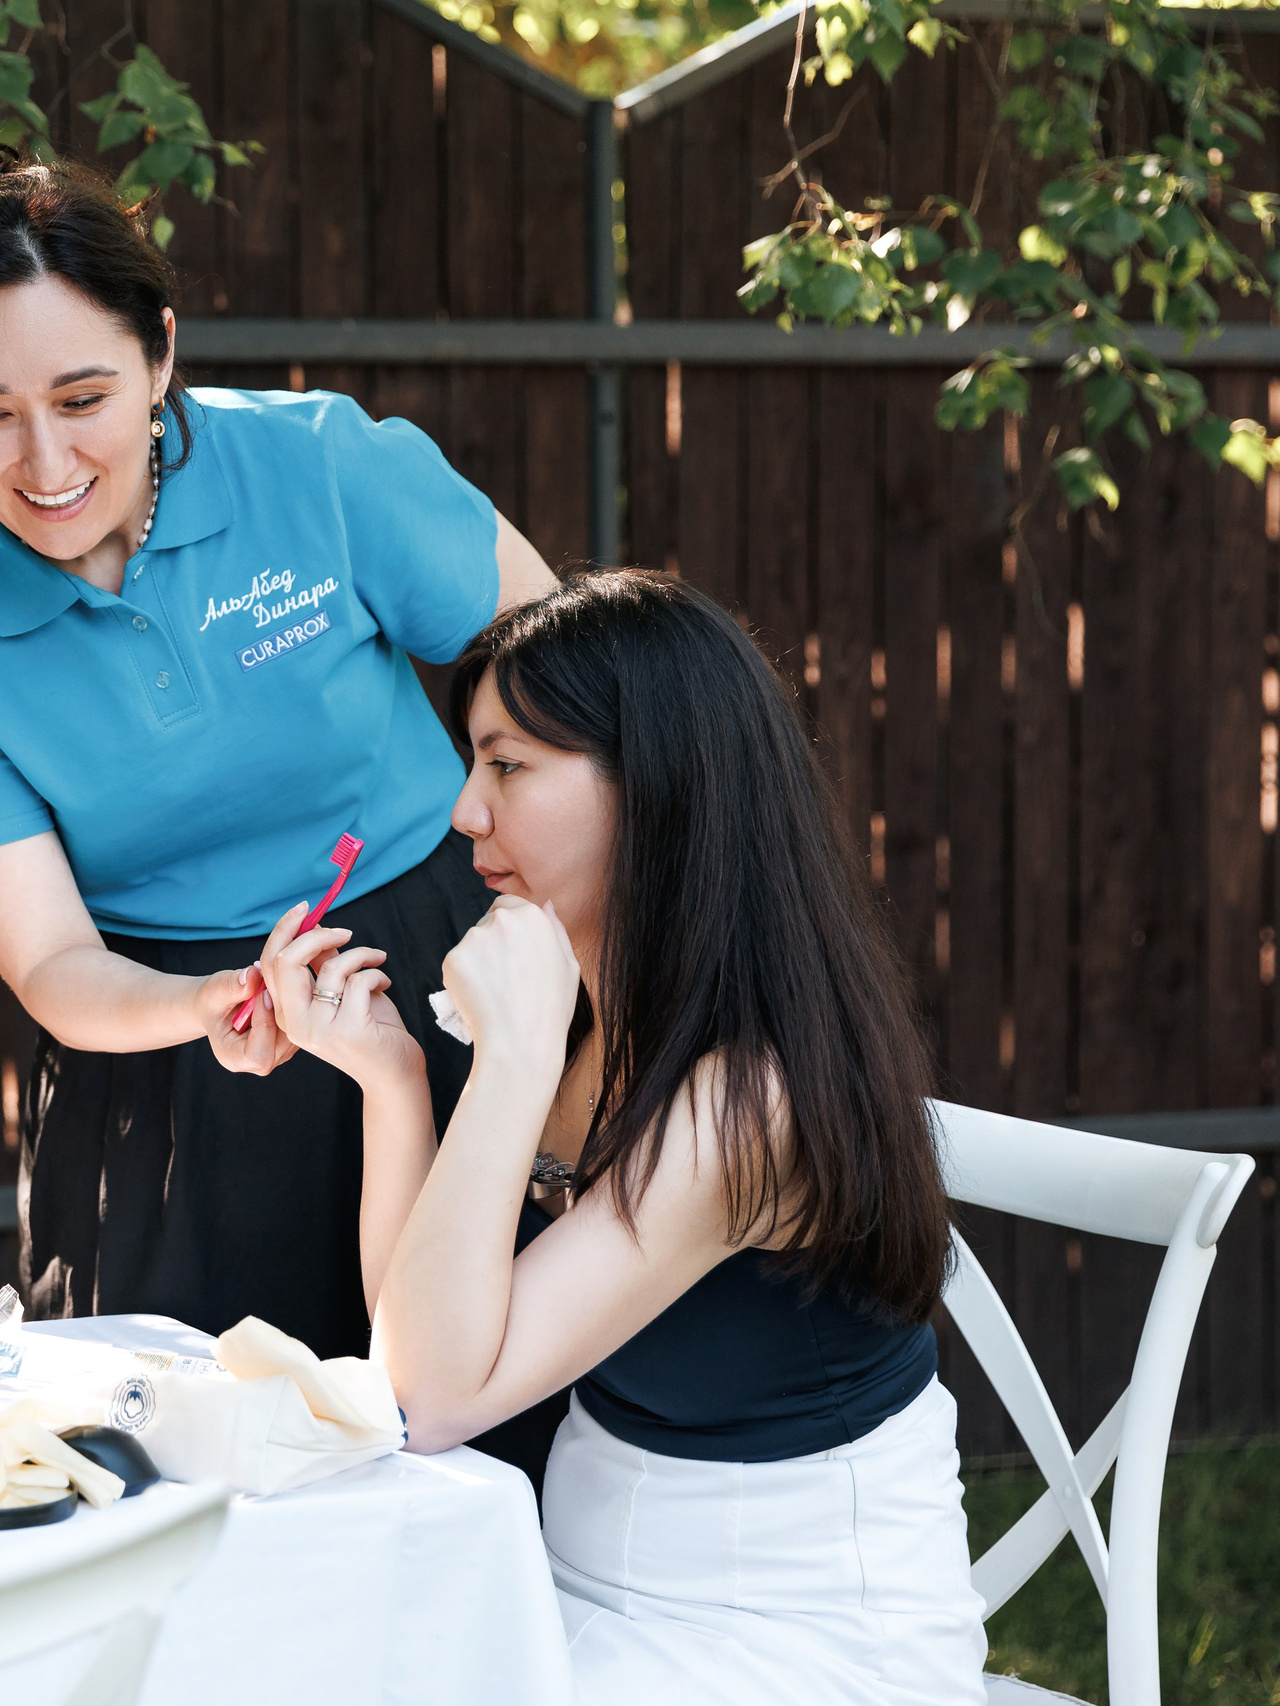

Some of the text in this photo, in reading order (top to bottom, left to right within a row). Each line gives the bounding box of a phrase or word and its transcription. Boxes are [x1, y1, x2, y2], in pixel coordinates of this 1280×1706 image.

[199, 567, 297, 632] Аль-Абед
[252, 576, 339, 629] Динара
[241, 612, 329, 667] CURAPROX
